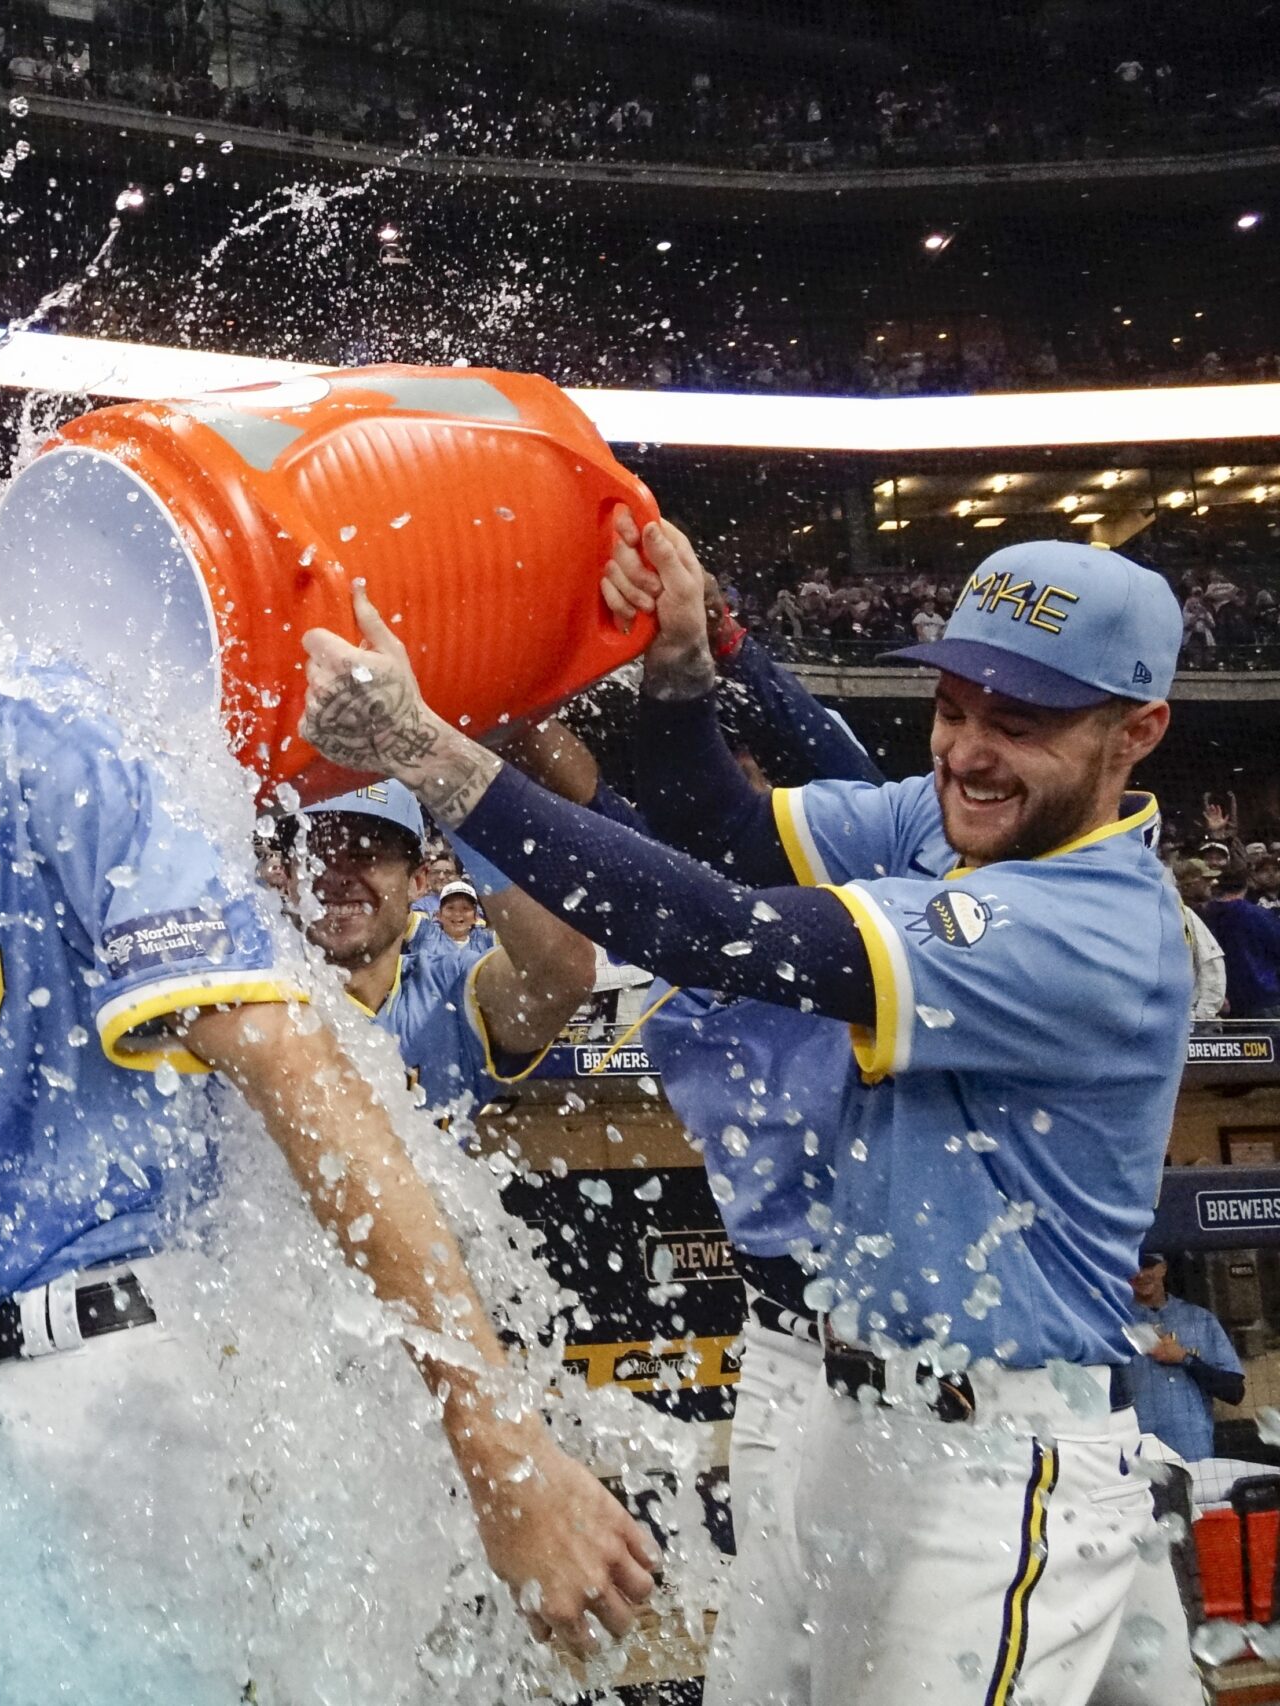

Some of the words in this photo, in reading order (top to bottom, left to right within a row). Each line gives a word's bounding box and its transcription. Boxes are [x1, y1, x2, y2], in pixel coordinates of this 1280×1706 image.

[955, 571, 1080, 634] MKE
[1188, 1042, 1268, 1058] BREWERS.COM
[1206, 1198, 1280, 1222] BREWERS
[656, 1241, 735, 1268] REWE
